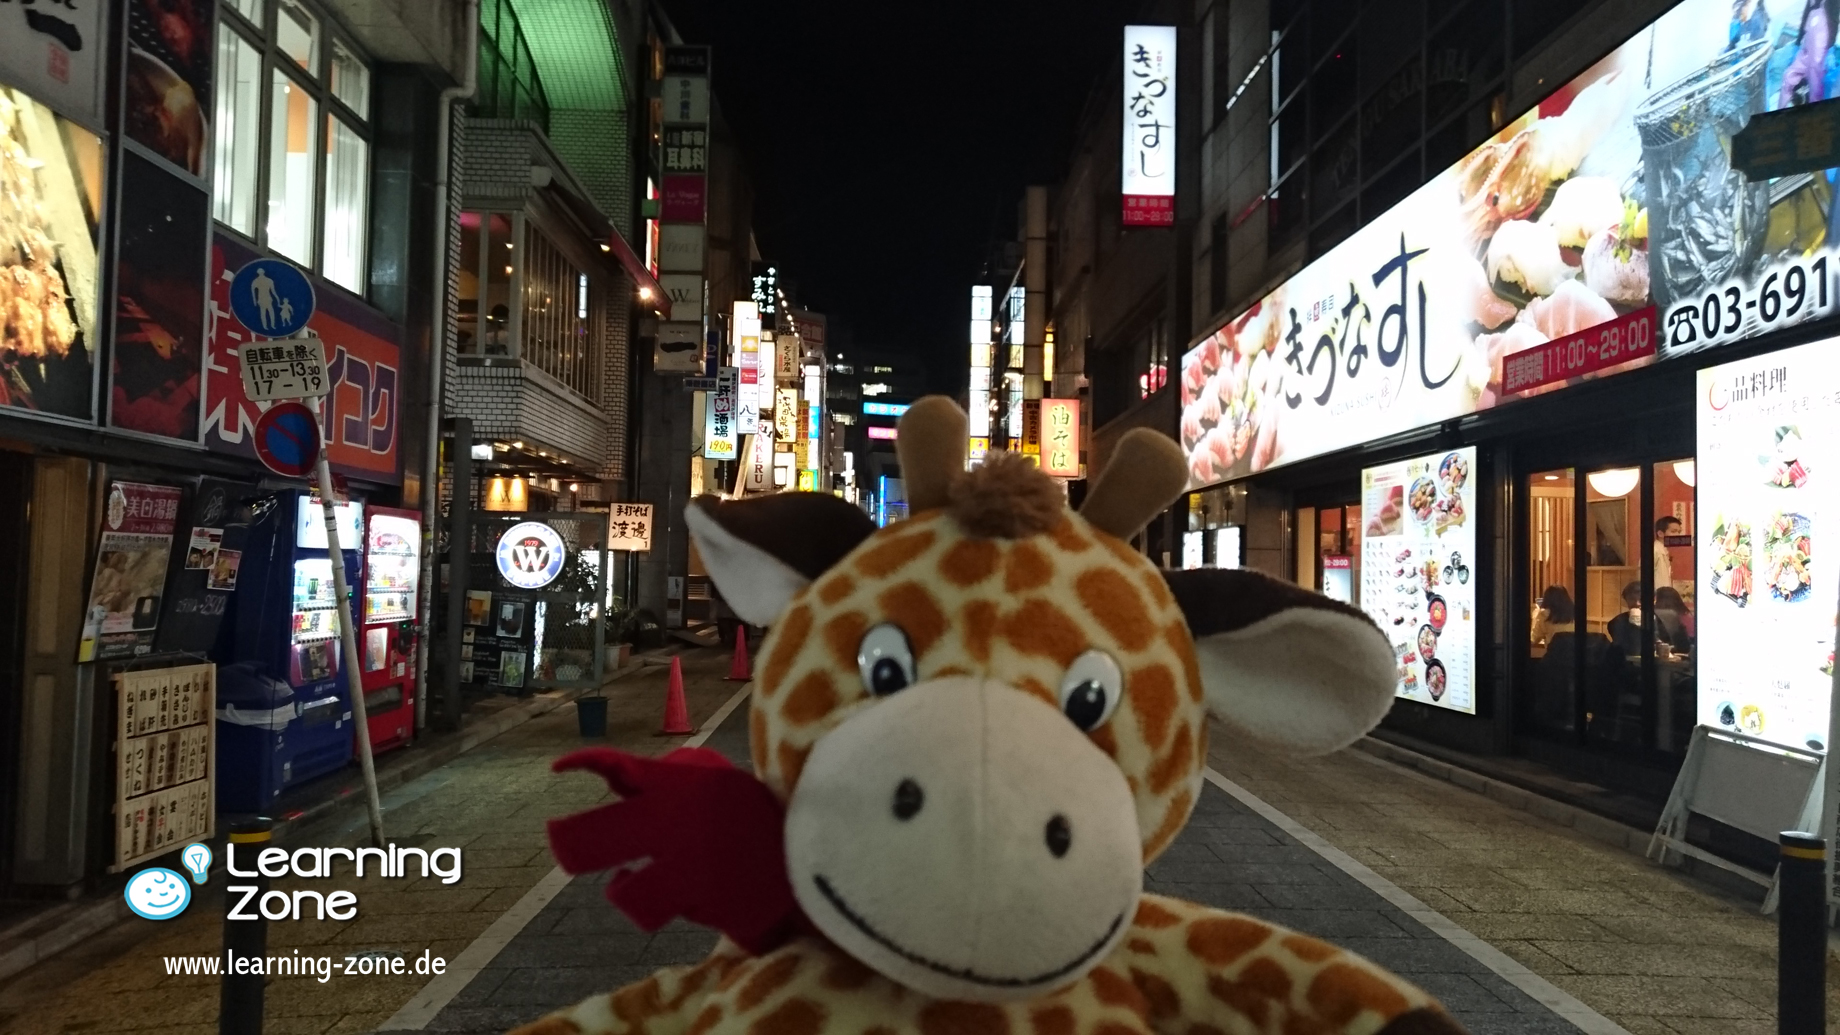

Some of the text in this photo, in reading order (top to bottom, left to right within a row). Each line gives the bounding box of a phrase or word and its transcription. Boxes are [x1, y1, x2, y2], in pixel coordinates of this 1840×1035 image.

[1129, 44, 1172, 177] きづなすし
[1701, 256, 1840, 340] 03-691
[1284, 231, 1462, 410] きづなすし
[245, 344, 318, 363] 自転車を除く
[1506, 350, 1544, 390] 営業時間
[616, 504, 649, 517] 手打そば
[514, 545, 549, 572] W
[133, 748, 144, 792] つくね
